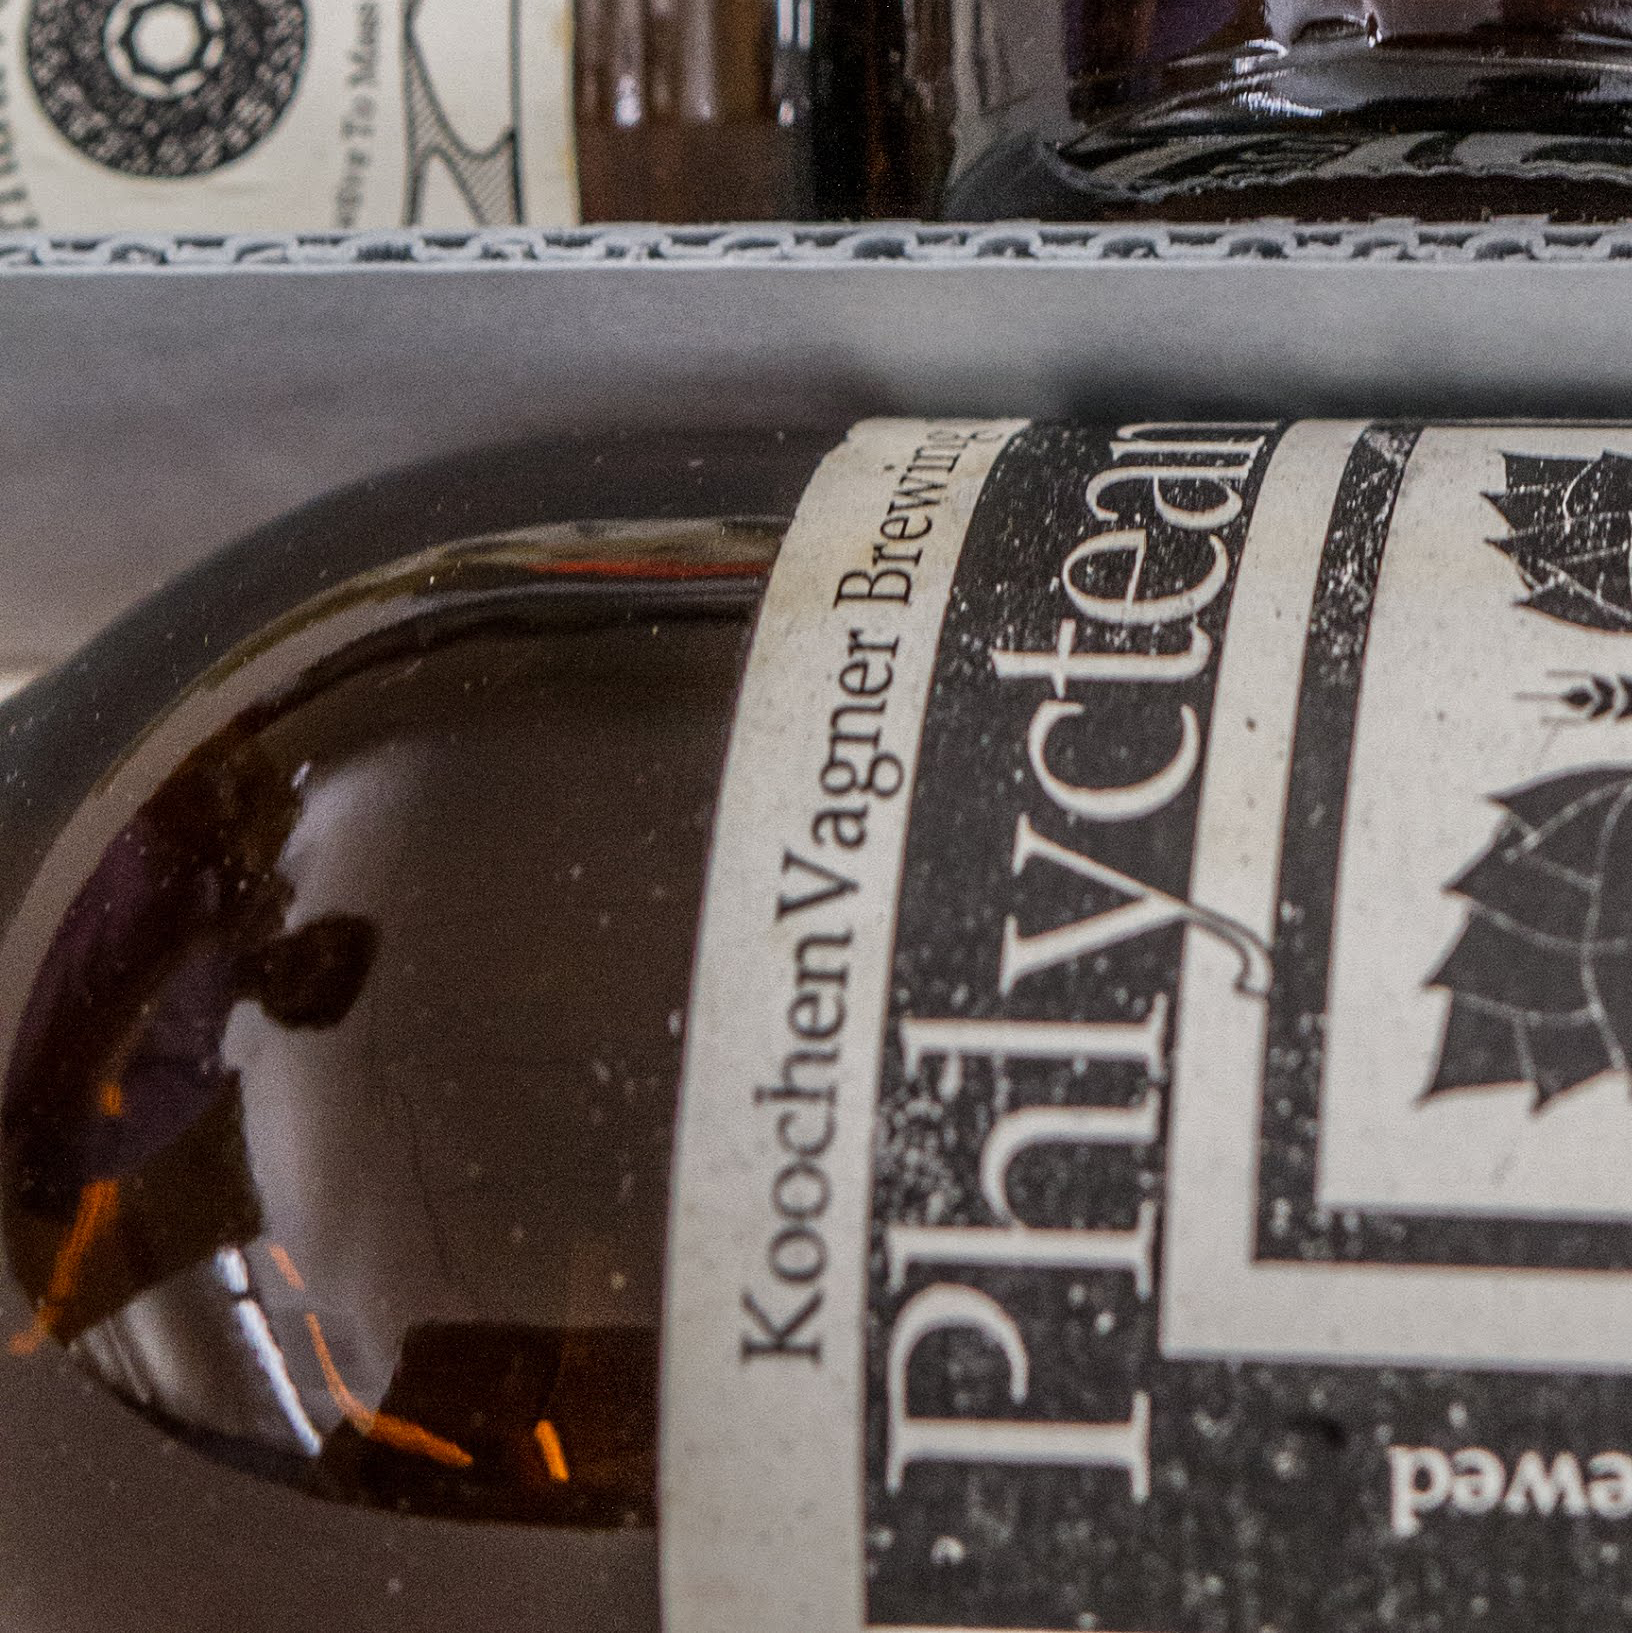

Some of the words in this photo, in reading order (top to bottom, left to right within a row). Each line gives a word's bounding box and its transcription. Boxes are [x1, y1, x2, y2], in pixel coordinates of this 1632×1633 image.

[740, 631, 905, 1367] KoochenVagner
[831, 429, 1004, 609] Brewing
[885, 420, 1280, 1503] Phlyctean
